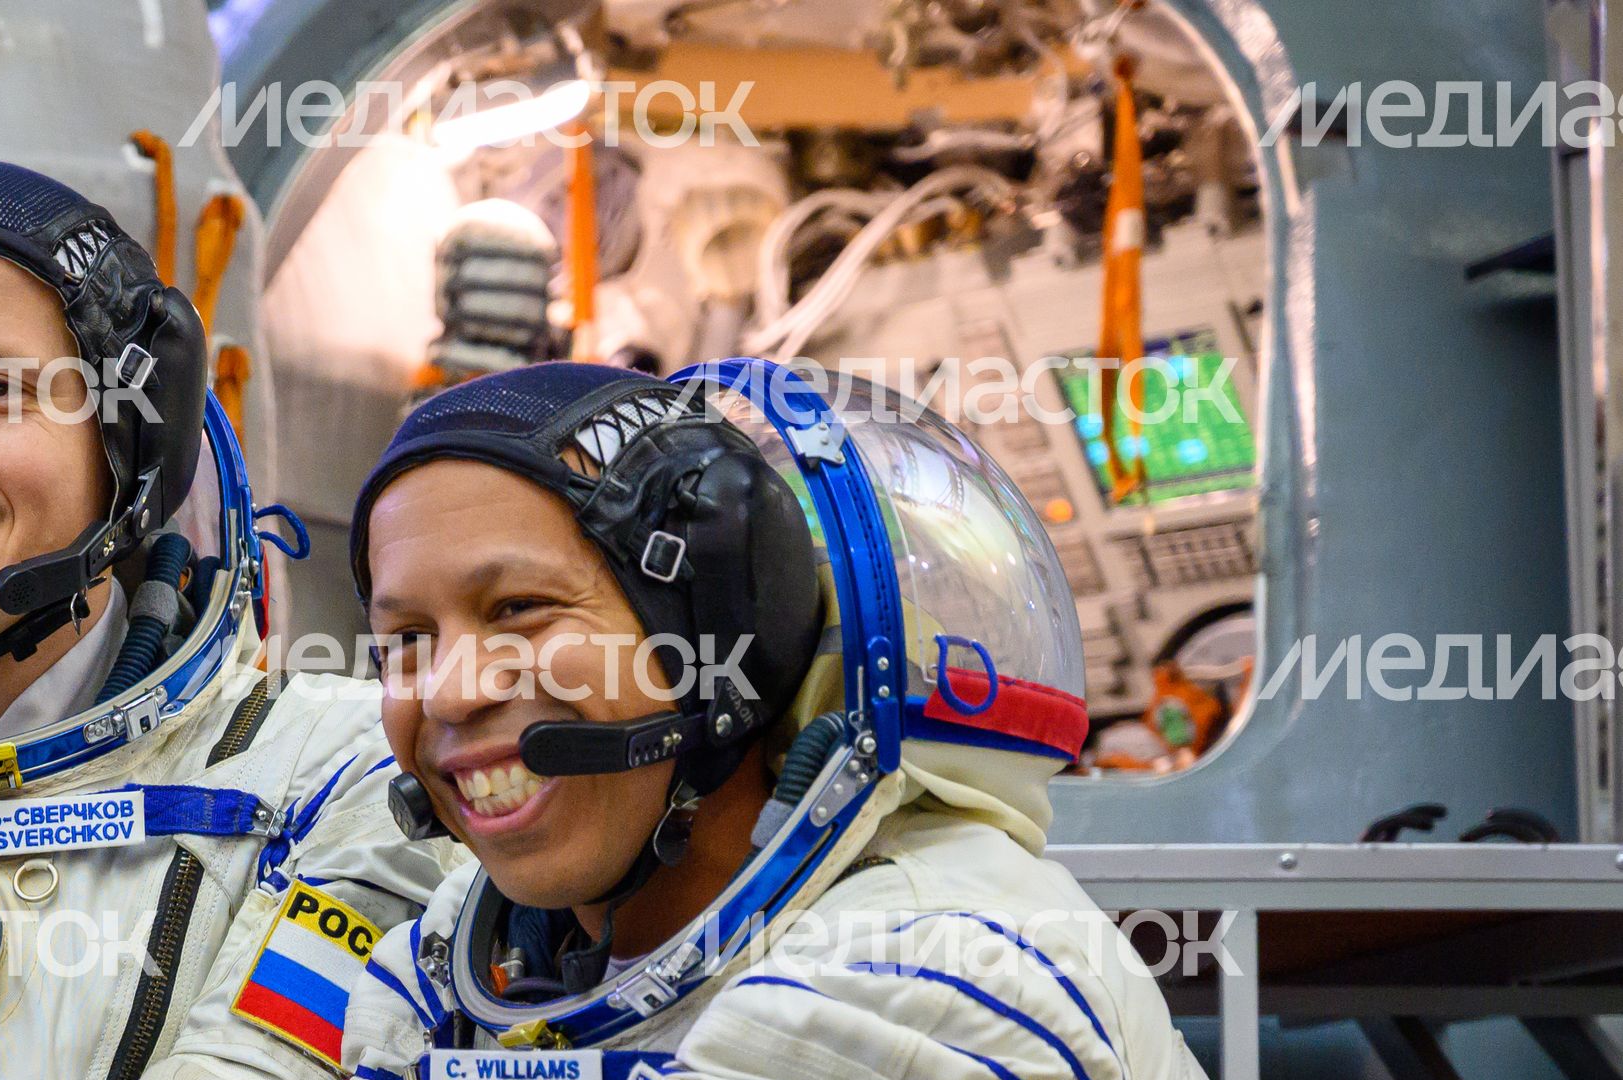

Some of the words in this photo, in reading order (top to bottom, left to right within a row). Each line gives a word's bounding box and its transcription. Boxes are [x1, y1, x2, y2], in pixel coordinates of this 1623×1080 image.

[286, 890, 374, 957] РОС
[446, 1056, 467, 1079] C.
[476, 1058, 581, 1080] WILLIAMS
